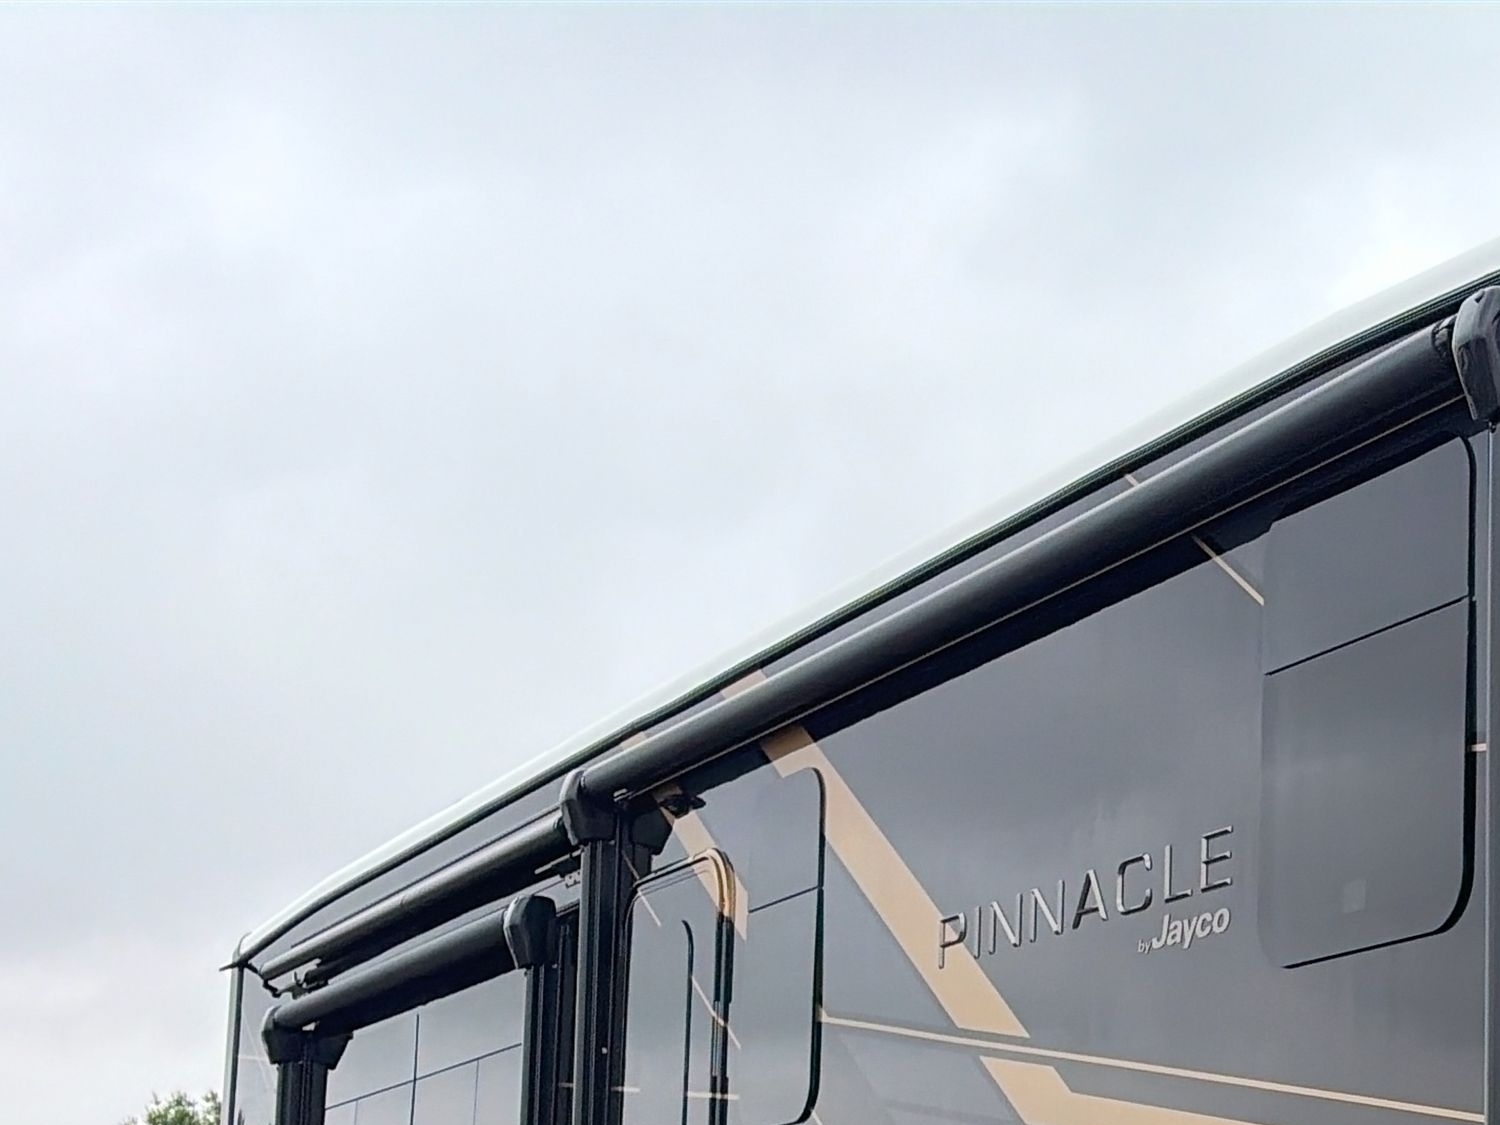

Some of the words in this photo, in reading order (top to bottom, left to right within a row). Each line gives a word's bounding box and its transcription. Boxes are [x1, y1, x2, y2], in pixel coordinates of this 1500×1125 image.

[938, 825, 1234, 969] PINNACLE
[1137, 939, 1151, 954] by
[1151, 907, 1230, 951] Jayco
